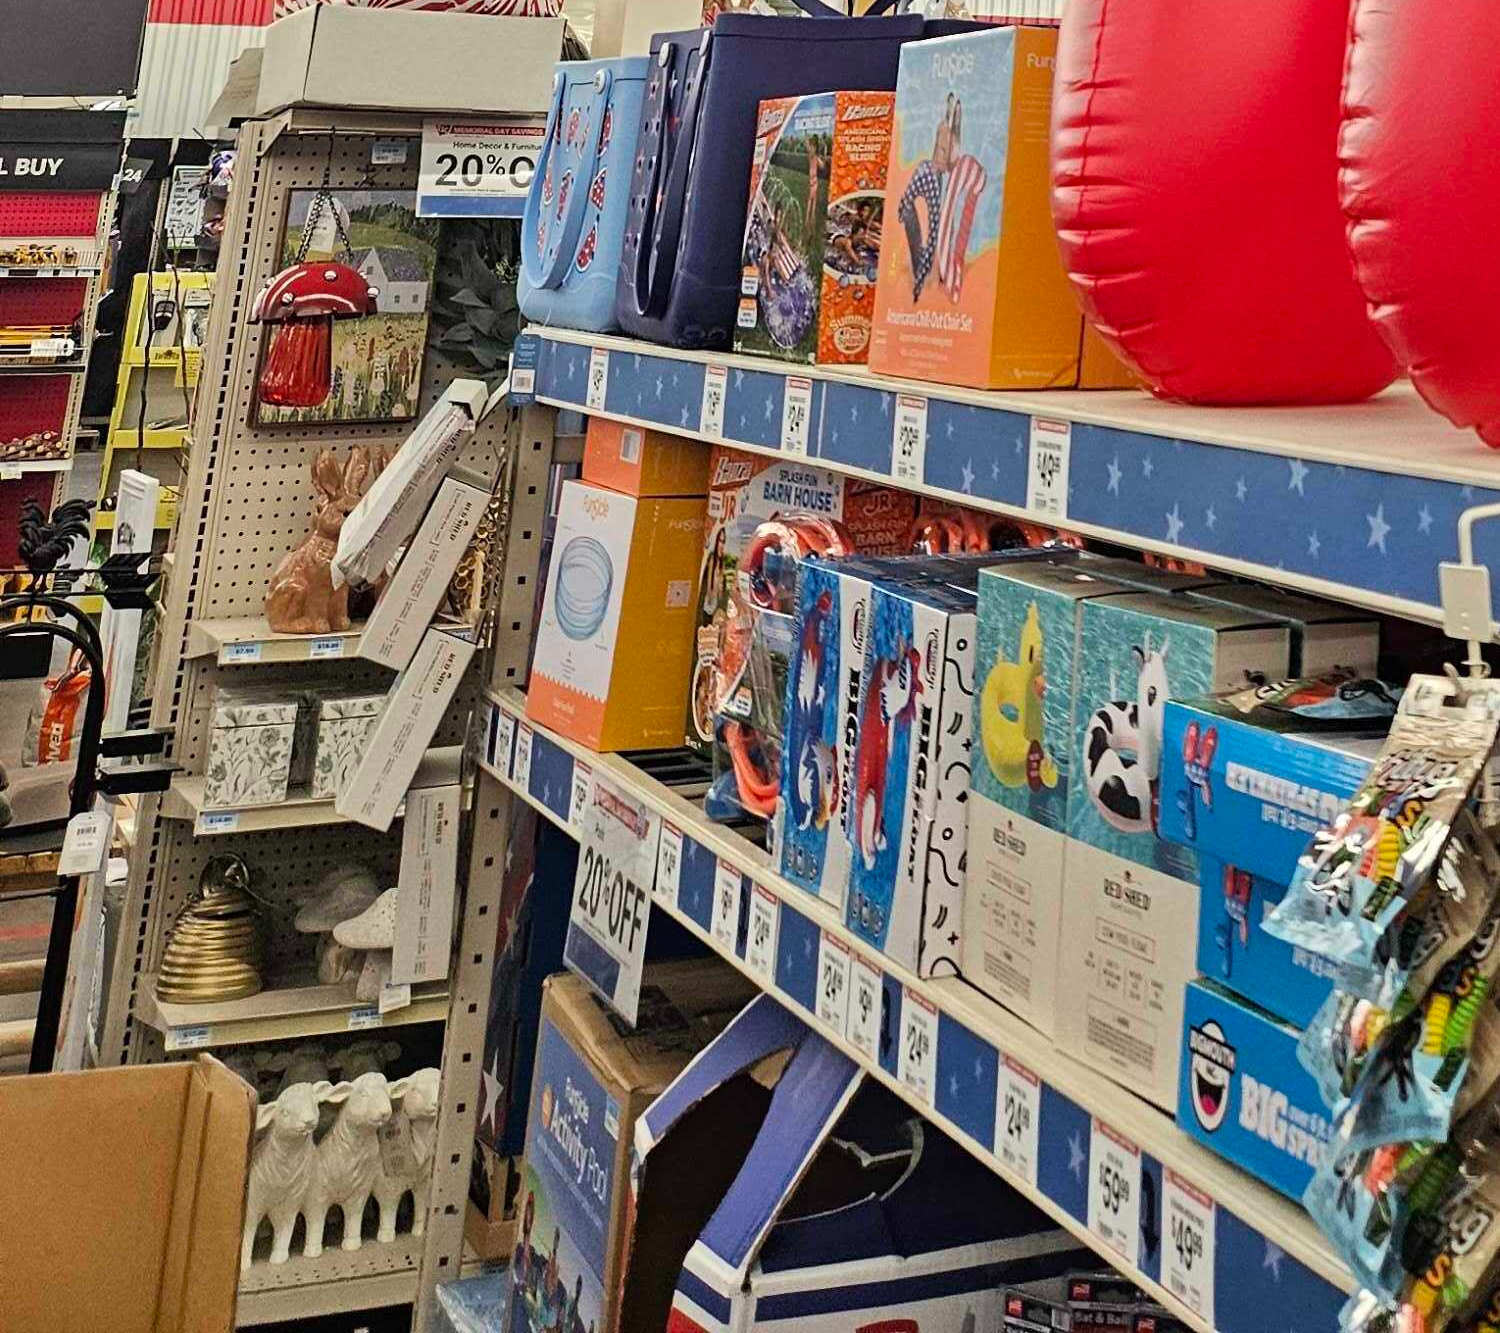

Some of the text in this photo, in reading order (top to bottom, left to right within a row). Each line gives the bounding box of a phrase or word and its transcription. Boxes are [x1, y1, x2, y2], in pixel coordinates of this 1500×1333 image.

[453, 141, 476, 150] Home
[478, 142, 502, 151] Decor
[14, 158, 64, 176] BUY
[779, 469, 804, 483] SPLASH
[763, 481, 833, 513] BARN HOUSE
[1104, 878, 1152, 911] RED SHED
[1239, 1073, 1288, 1150] BIG
[550, 1100, 608, 1206] Activity Pool
[1075, 1308, 1098, 1322] Bat
[1099, 1311, 1110, 1324] &
